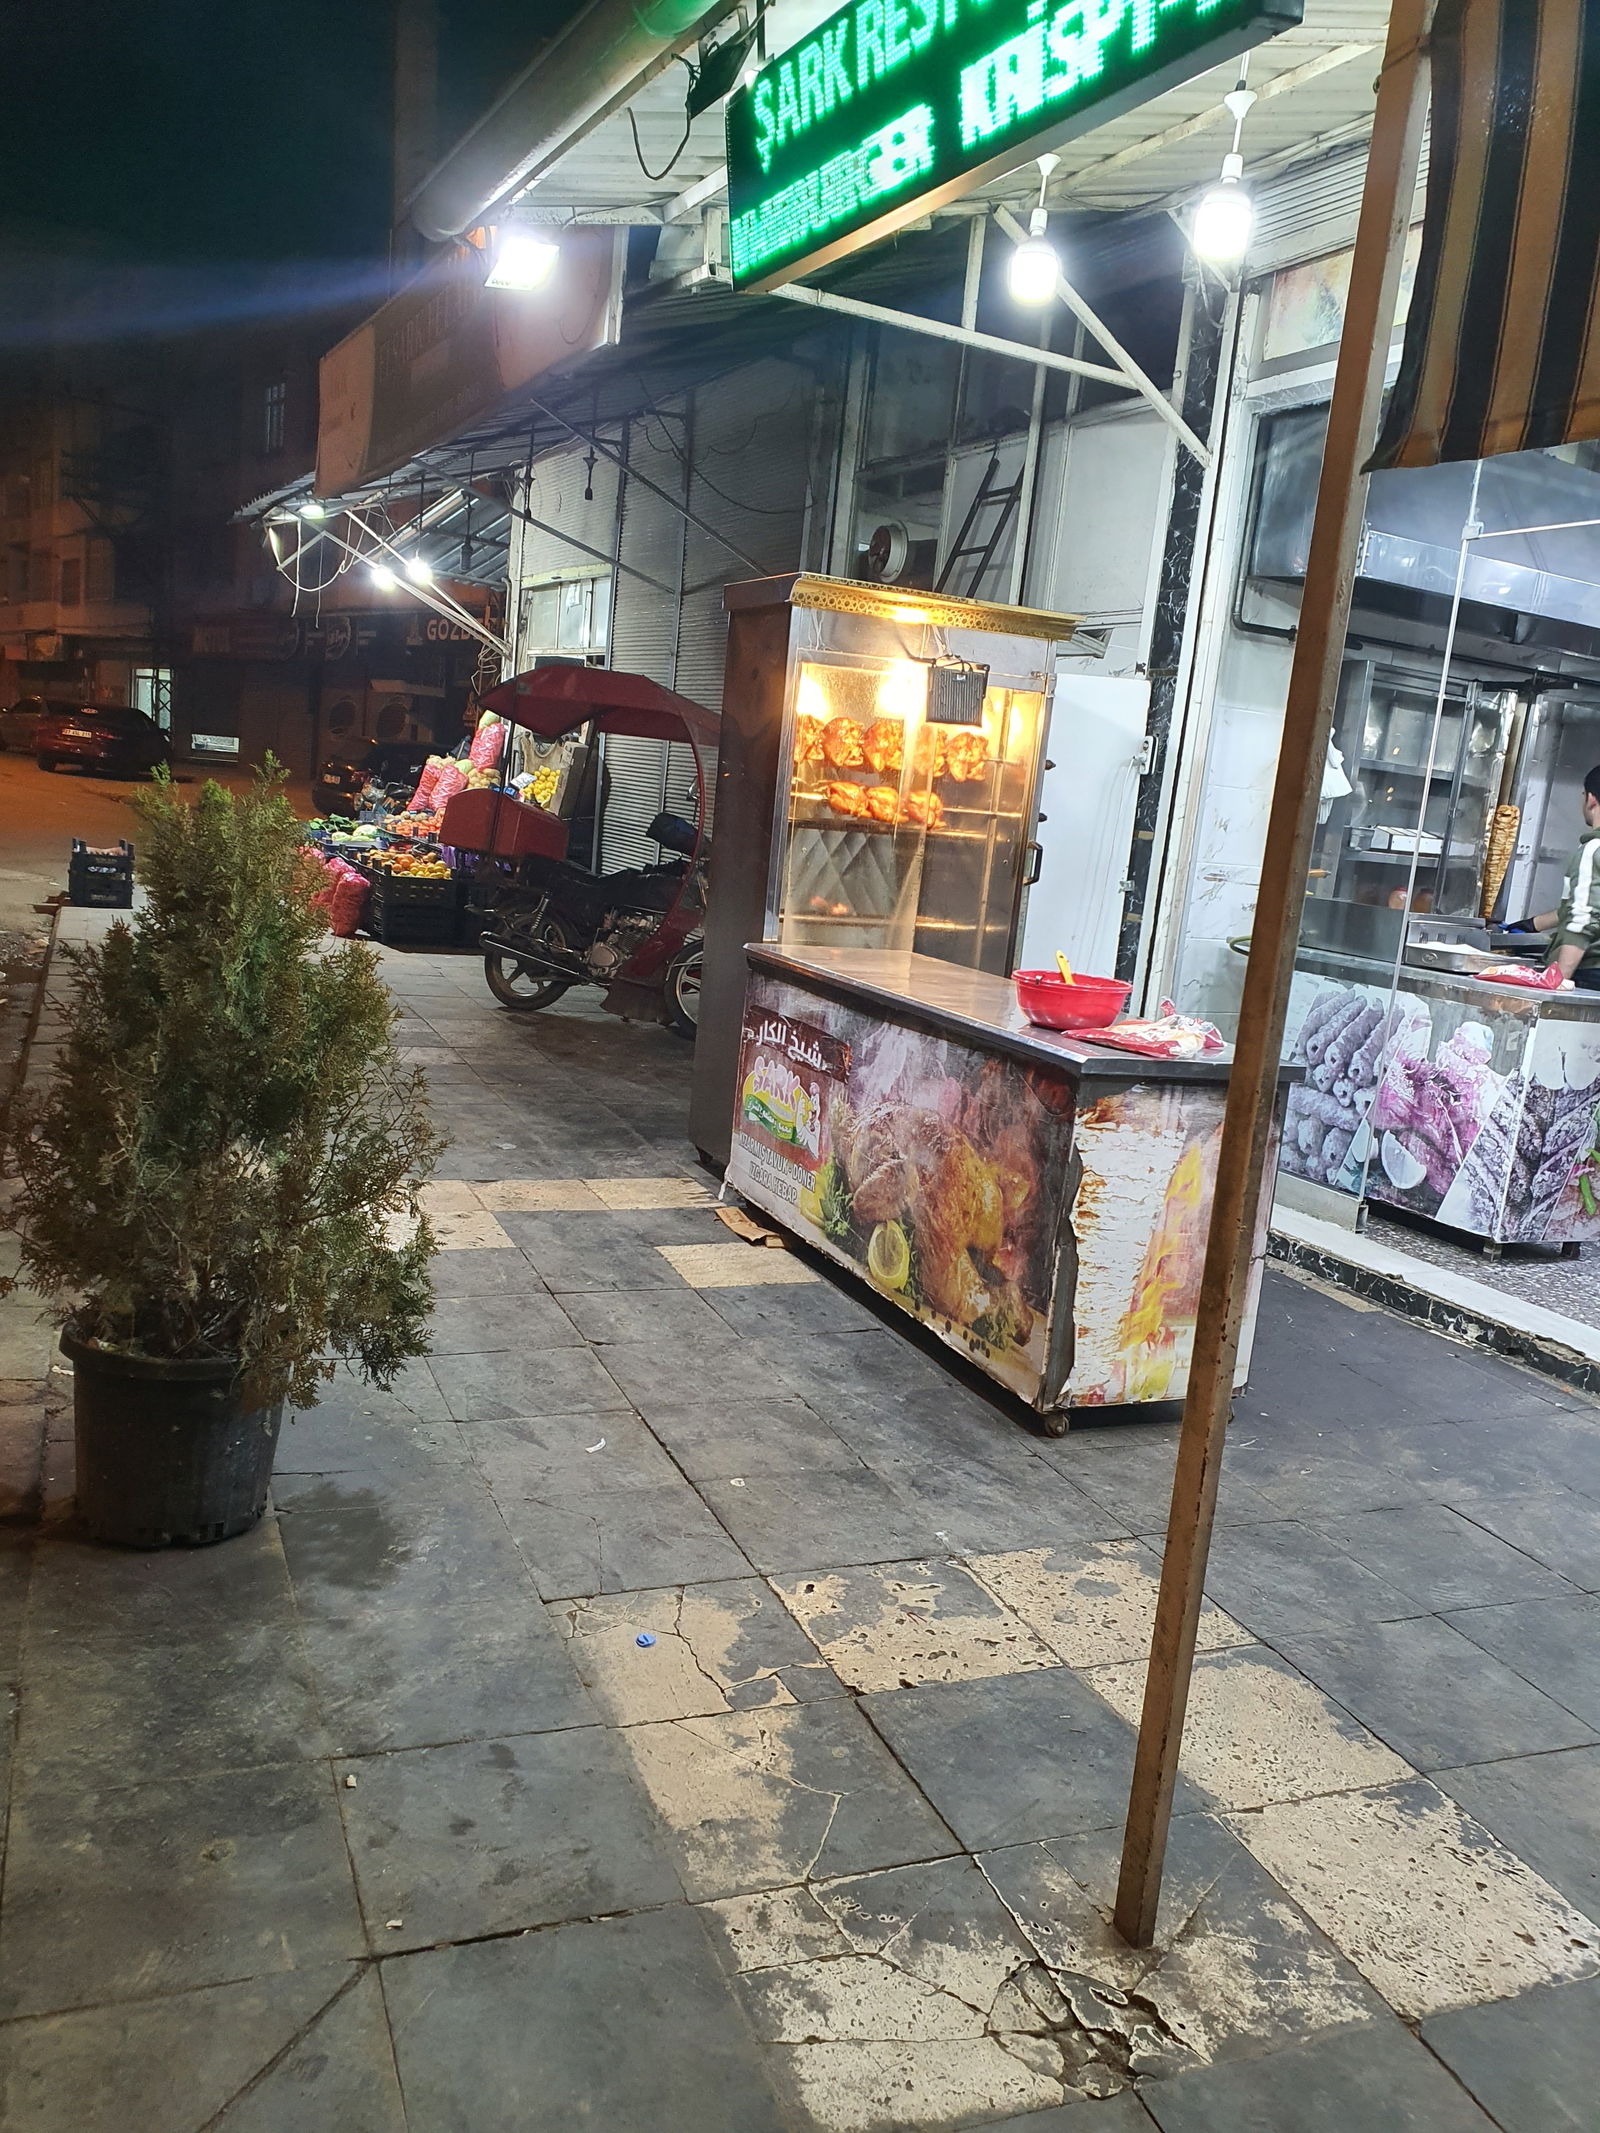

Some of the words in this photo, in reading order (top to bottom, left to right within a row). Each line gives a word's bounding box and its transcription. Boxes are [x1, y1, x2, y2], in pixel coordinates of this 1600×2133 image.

[754, 18, 854, 173] ŞARK
[756, 1020, 787, 1046] الكار
[788, 1030, 823, 1069] شيخ
[766, 1148, 788, 1175] TAVUK
[772, 1176, 797, 1204] KEBAP
